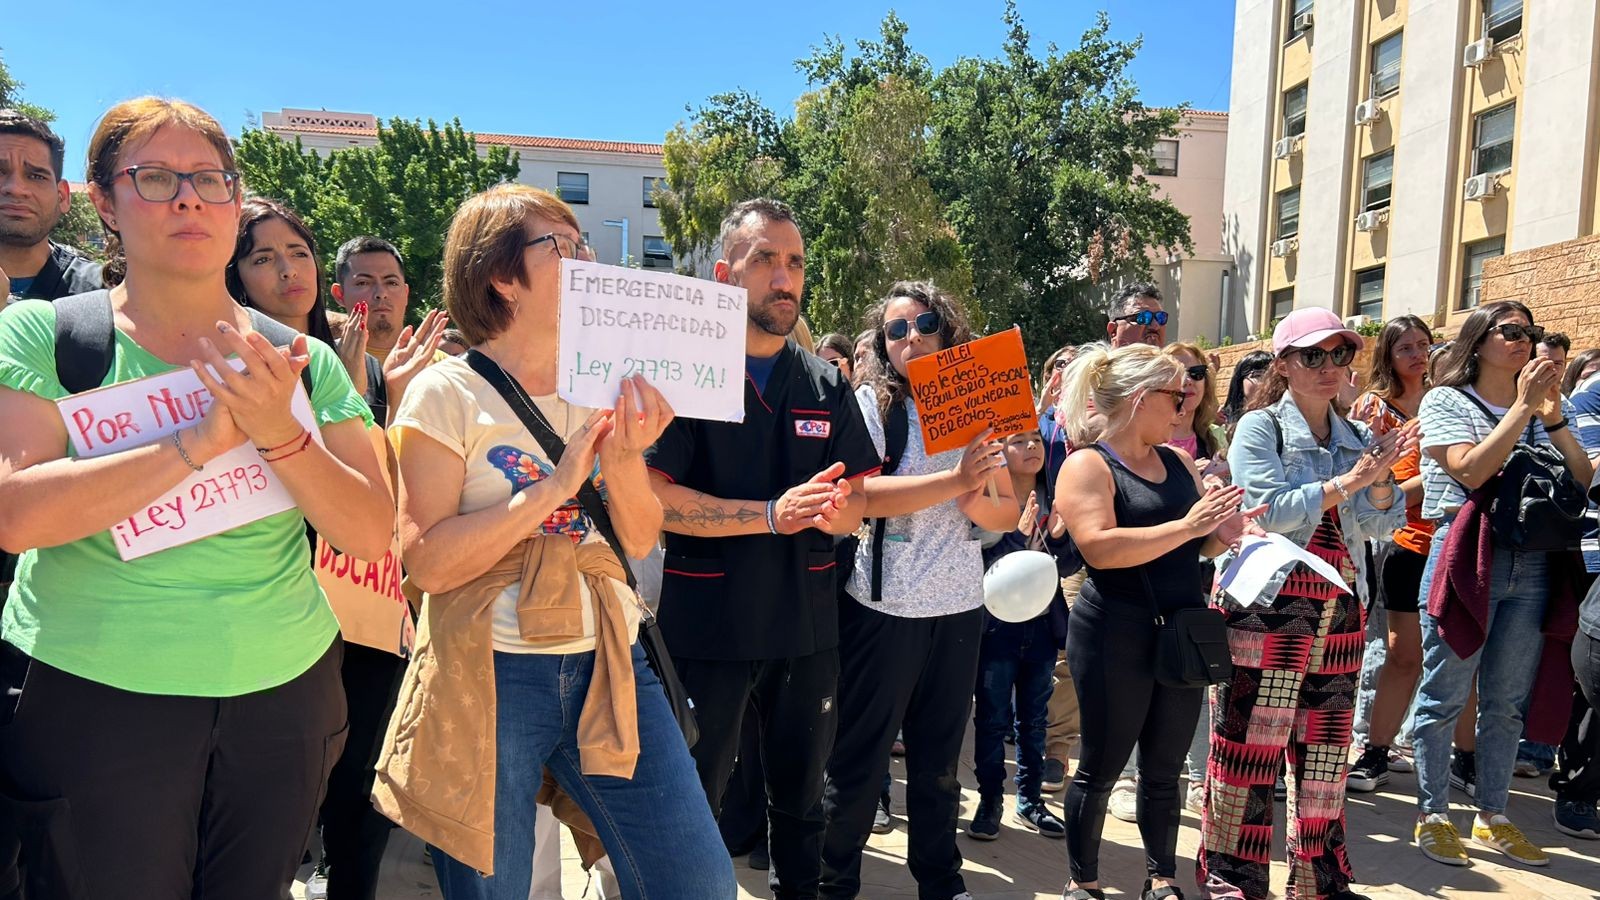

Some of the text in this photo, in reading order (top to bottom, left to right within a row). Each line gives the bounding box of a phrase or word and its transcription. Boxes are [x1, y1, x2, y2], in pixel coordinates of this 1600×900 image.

[569, 269, 743, 311] EMERGENCIA EN
[580, 306, 727, 340] DISCAPACIDAD
[936, 344, 971, 367] MILEI
[621, 357, 682, 381] 27793
[692, 363, 726, 389] YA!
[964, 384, 1020, 409] VULNERAR
[190, 464, 269, 512] 27793
